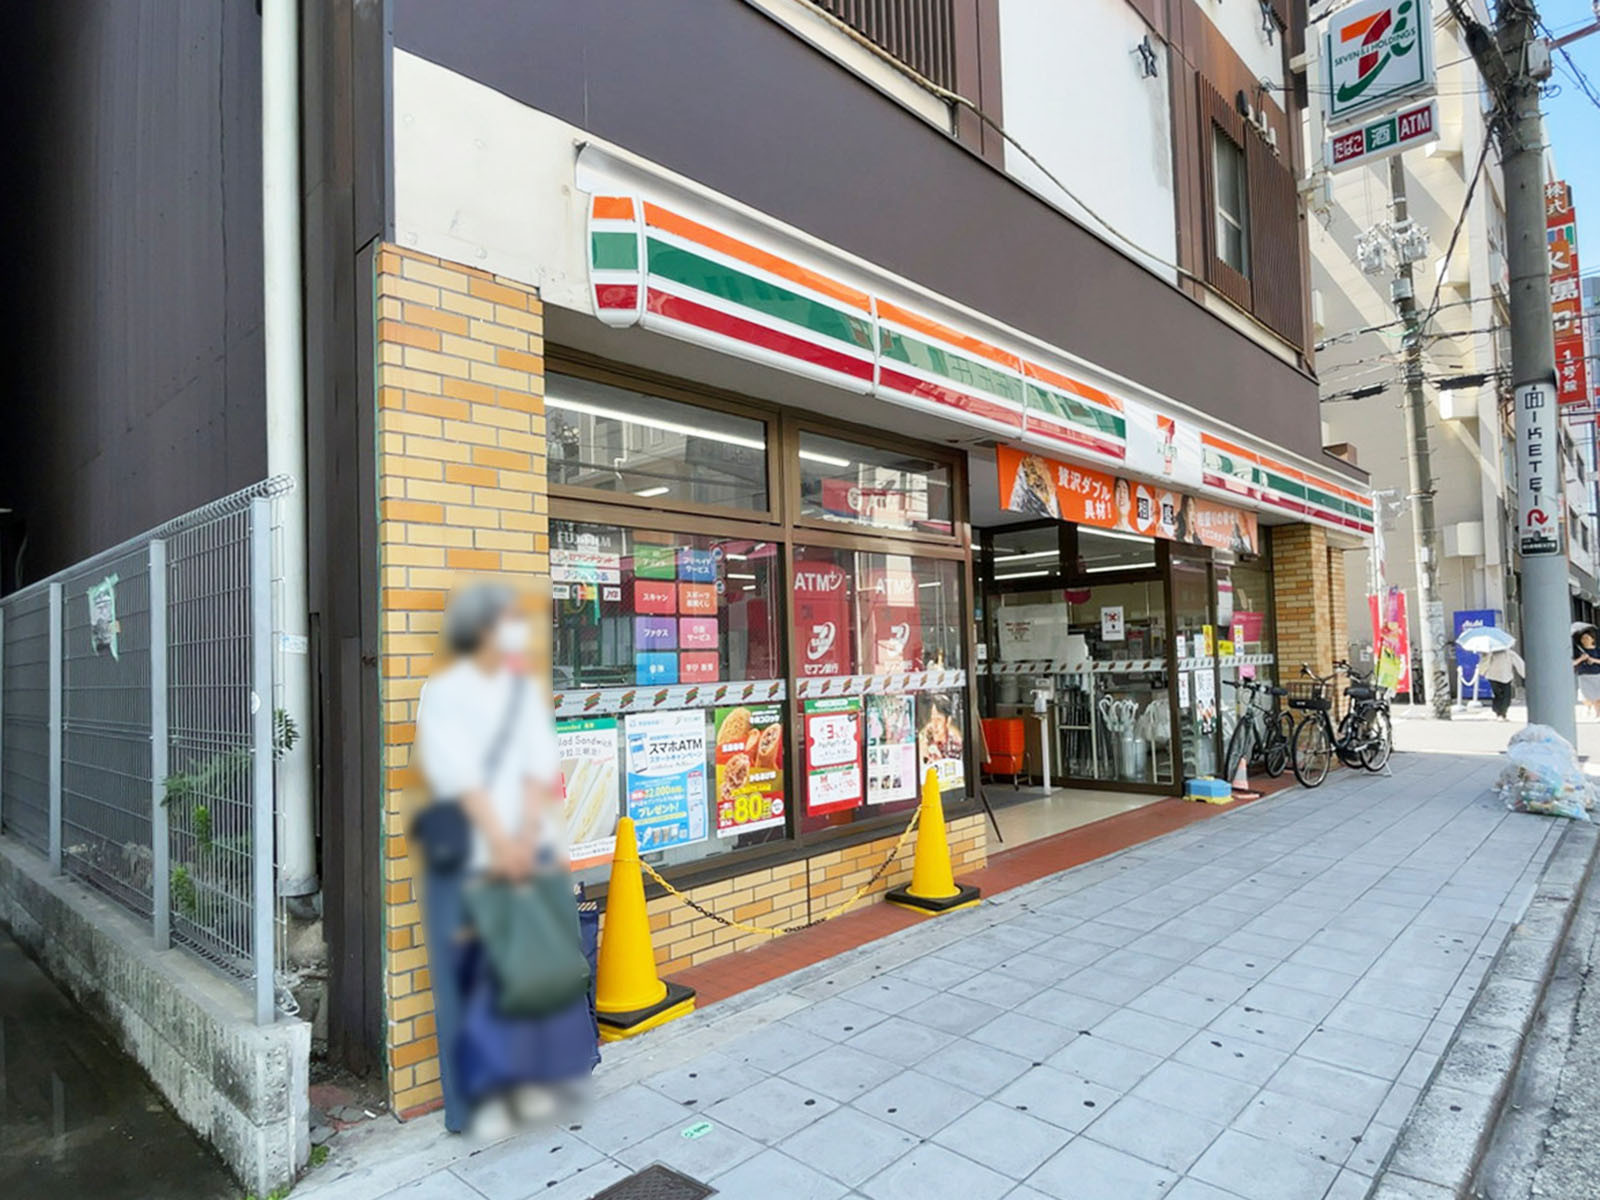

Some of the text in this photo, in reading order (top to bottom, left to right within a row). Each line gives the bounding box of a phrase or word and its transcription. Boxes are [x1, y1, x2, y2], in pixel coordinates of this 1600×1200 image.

[1371, 123, 1391, 148] 酒
[1400, 110, 1431, 138] ATM
[1335, 134, 1364, 158] たばこ
[794, 572, 830, 592] ATM
[649, 738, 703, 755] スマホATM
[638, 801, 680, 818] プレゼント!
[734, 794, 762, 823] 80
